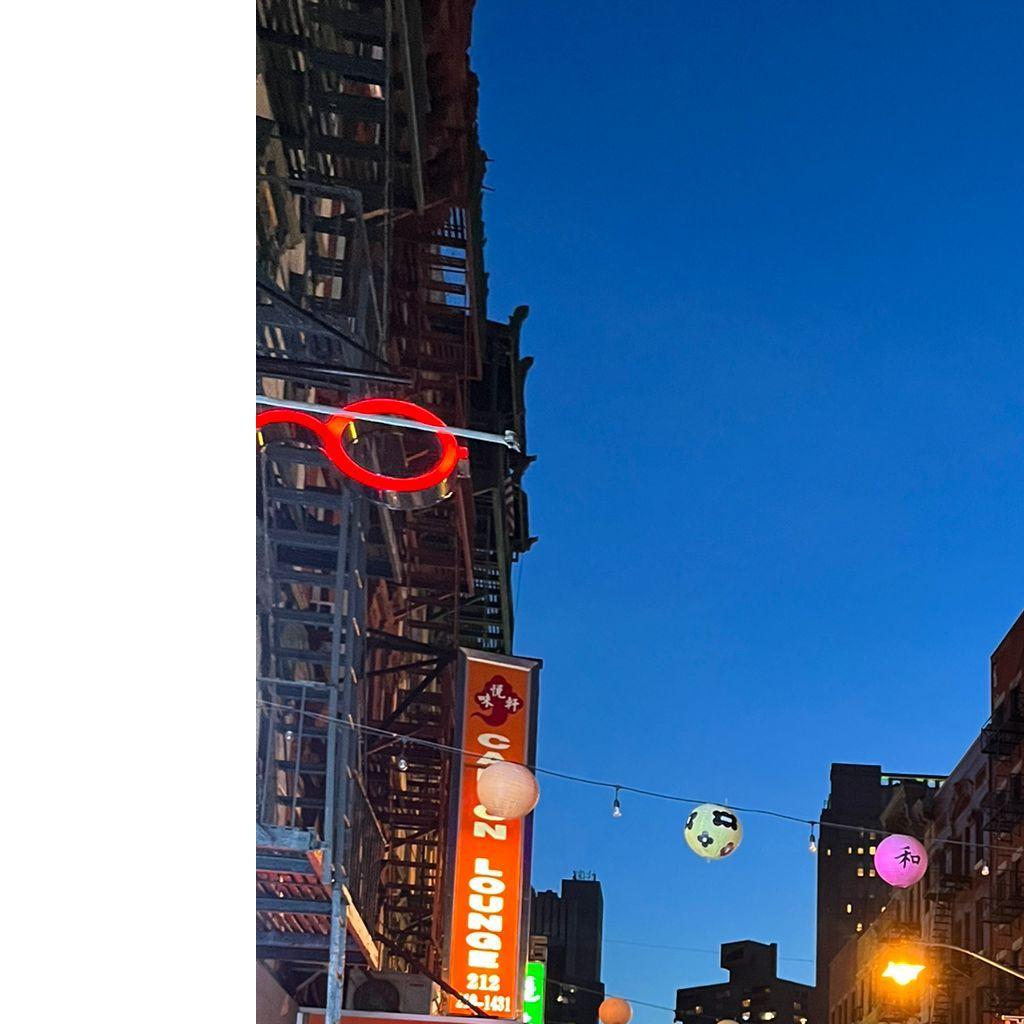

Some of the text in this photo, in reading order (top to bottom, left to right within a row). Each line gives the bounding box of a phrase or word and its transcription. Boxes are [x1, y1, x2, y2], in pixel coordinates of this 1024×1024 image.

[894, 846, 921, 869] 和
[465, 857, 506, 970] LOUNGE
[466, 973, 501, 991] 212
